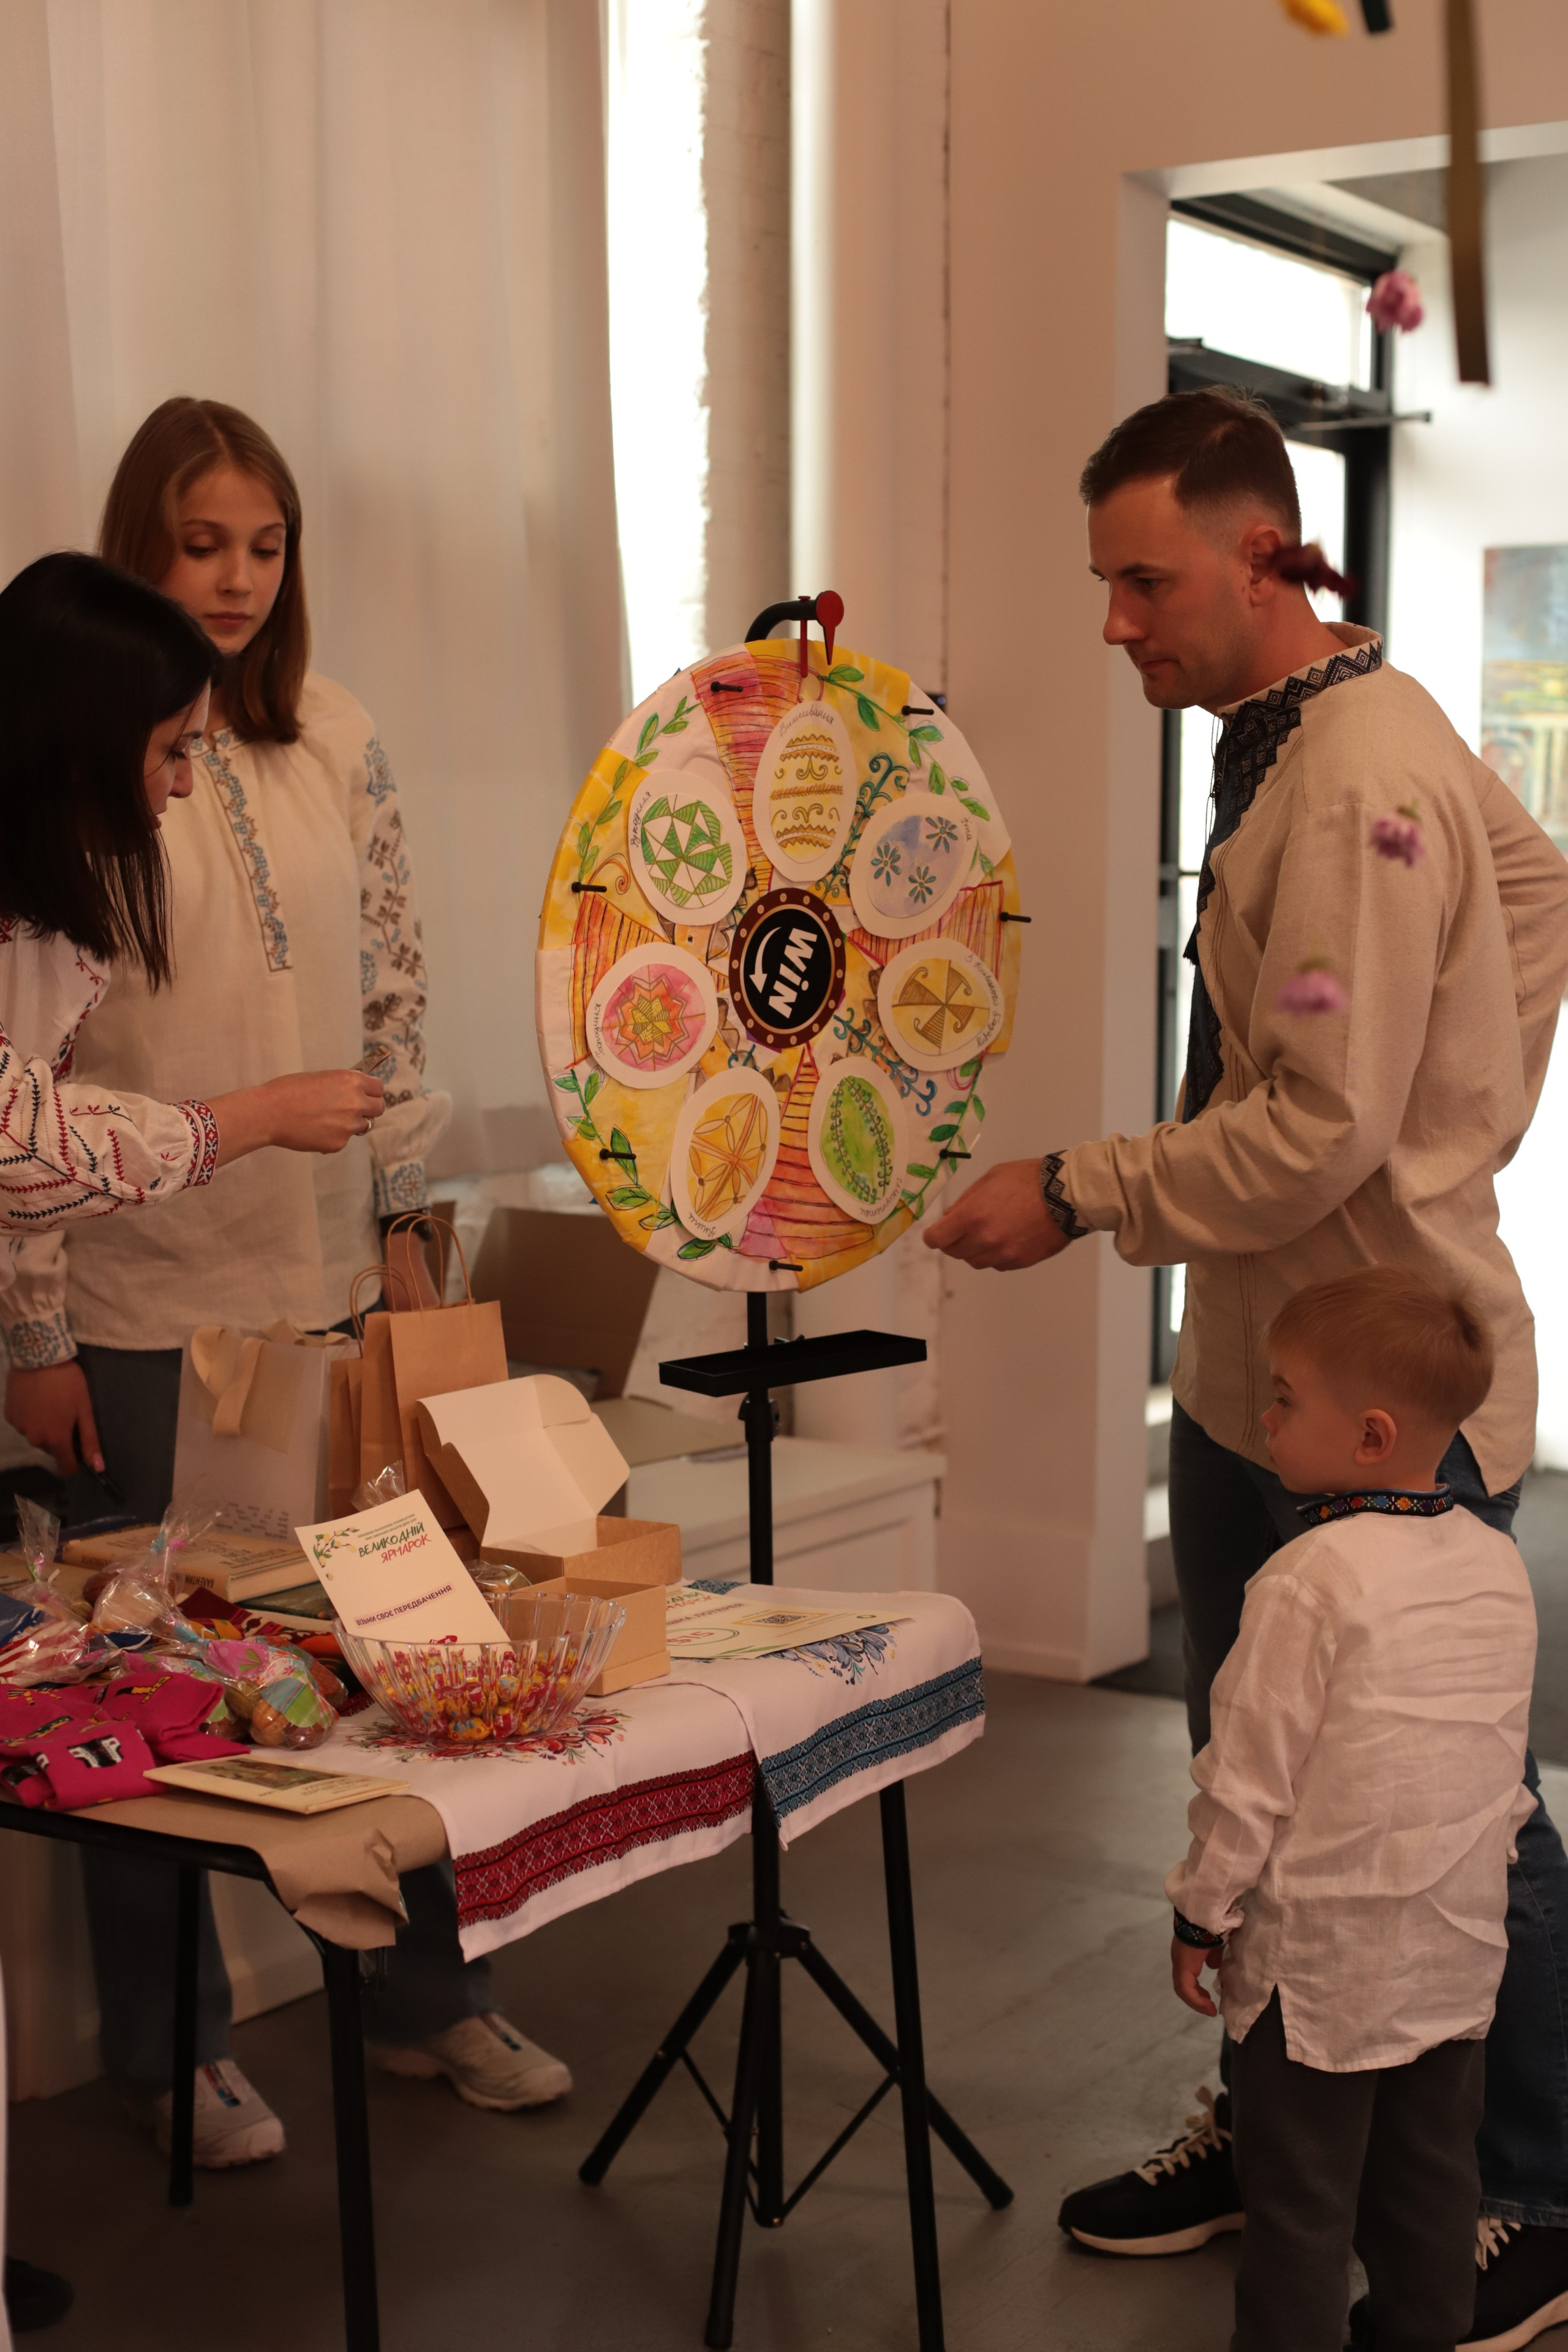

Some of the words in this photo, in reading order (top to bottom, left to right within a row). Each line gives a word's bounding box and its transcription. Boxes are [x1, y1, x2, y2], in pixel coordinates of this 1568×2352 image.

[358, 1521, 424, 1558] ВЕЛИКОДНІЙ
[381, 1533, 432, 1564] ЯРМАРОК
[356, 1616, 377, 1626] ВІЗЬМИ
[376, 1610, 394, 1621] СВОЄ
[394, 1585, 452, 1615] ПЕРЕДБАЧЕННЯ
